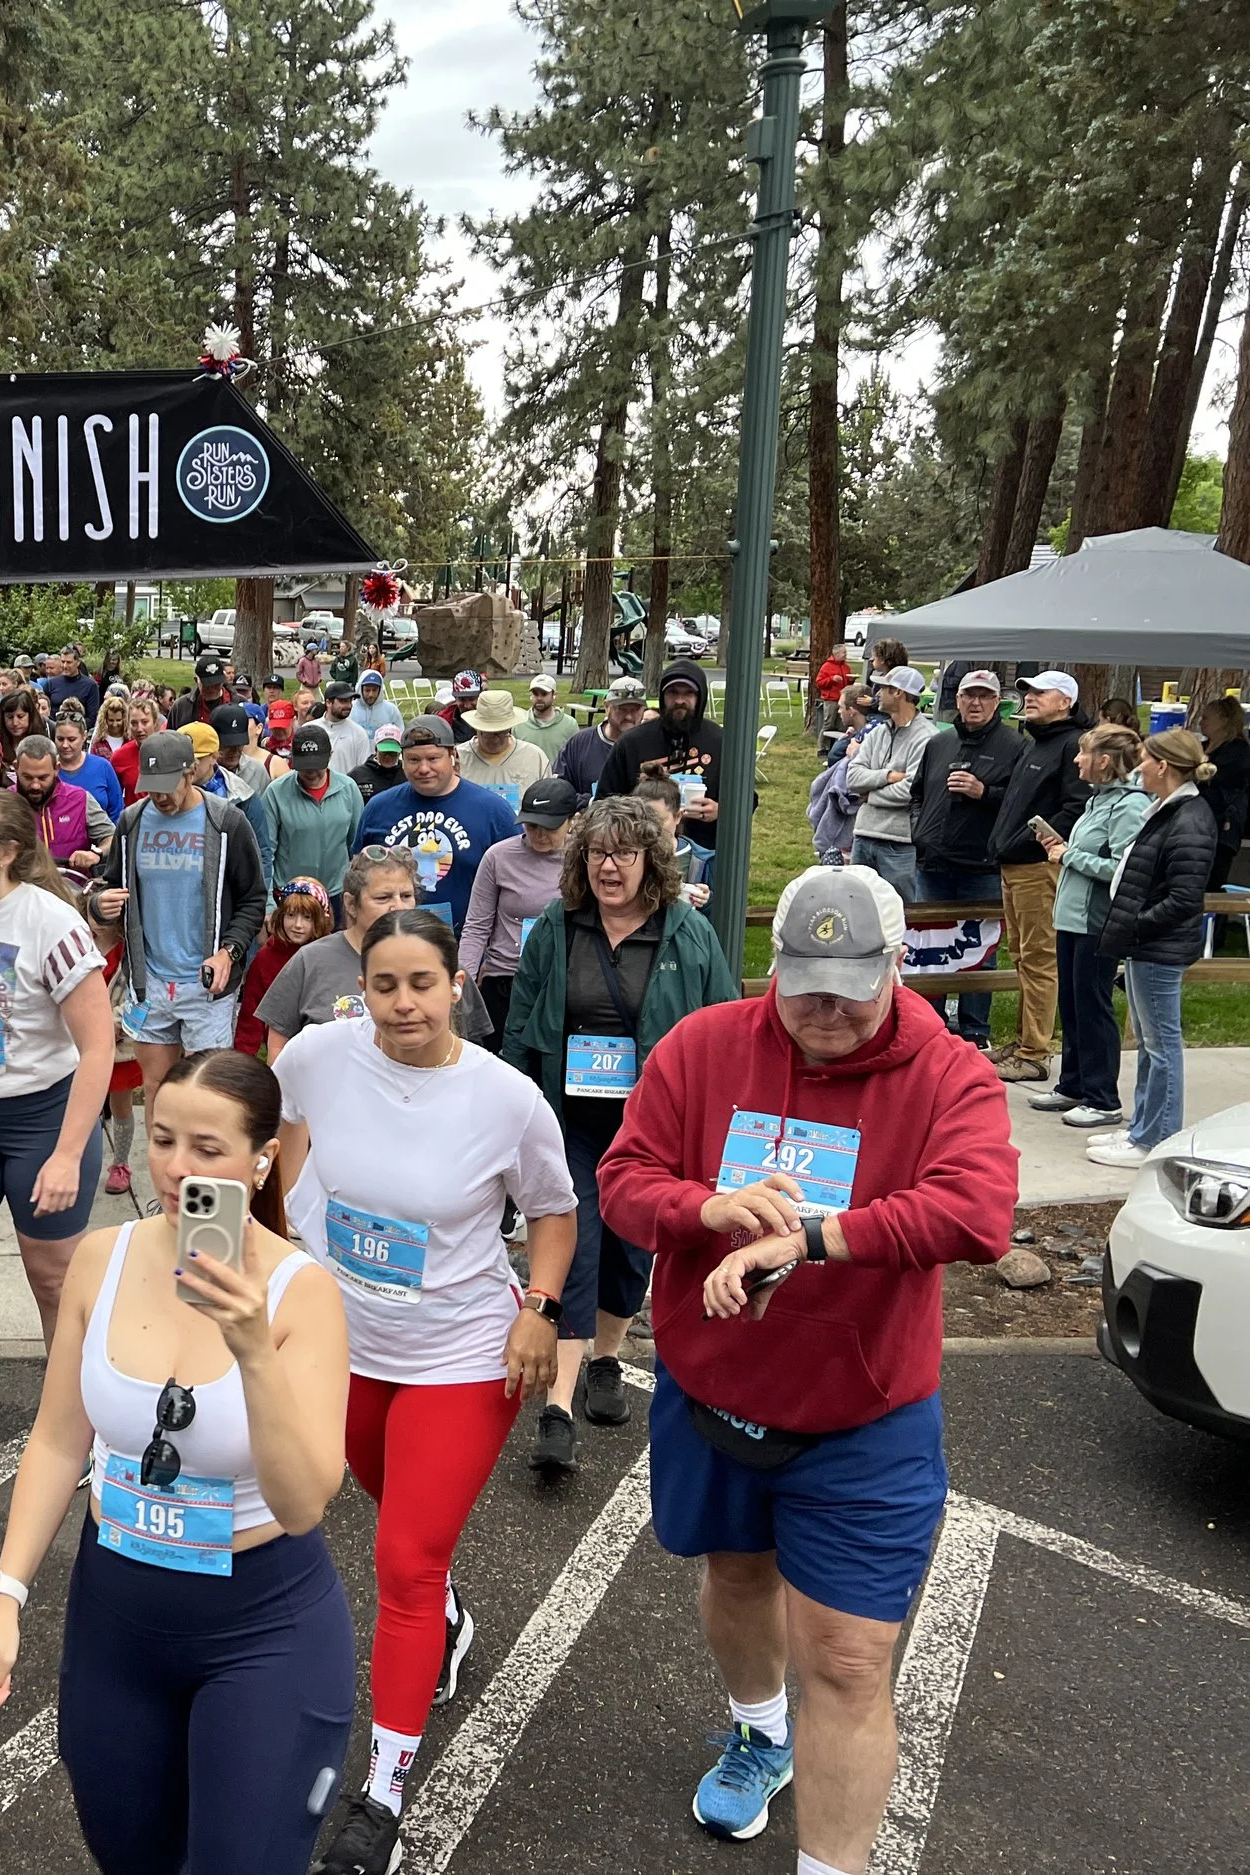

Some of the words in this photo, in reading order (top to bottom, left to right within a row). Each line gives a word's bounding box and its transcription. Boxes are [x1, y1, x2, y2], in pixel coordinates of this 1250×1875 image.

[186, 458, 257, 492] SISTERS
[203, 484, 241, 510] RUN
[141, 830, 205, 850] LOVE
[385, 815, 413, 846] BEST
[415, 811, 445, 823] DAD
[443, 816, 471, 850] EVER
[592, 1053, 623, 1071] 207
[761, 1142, 815, 1176] 292
[793, 1204, 832, 1217] AKFAST
[352, 1233, 390, 1262] 196
[134, 1499, 185, 1539] 195
